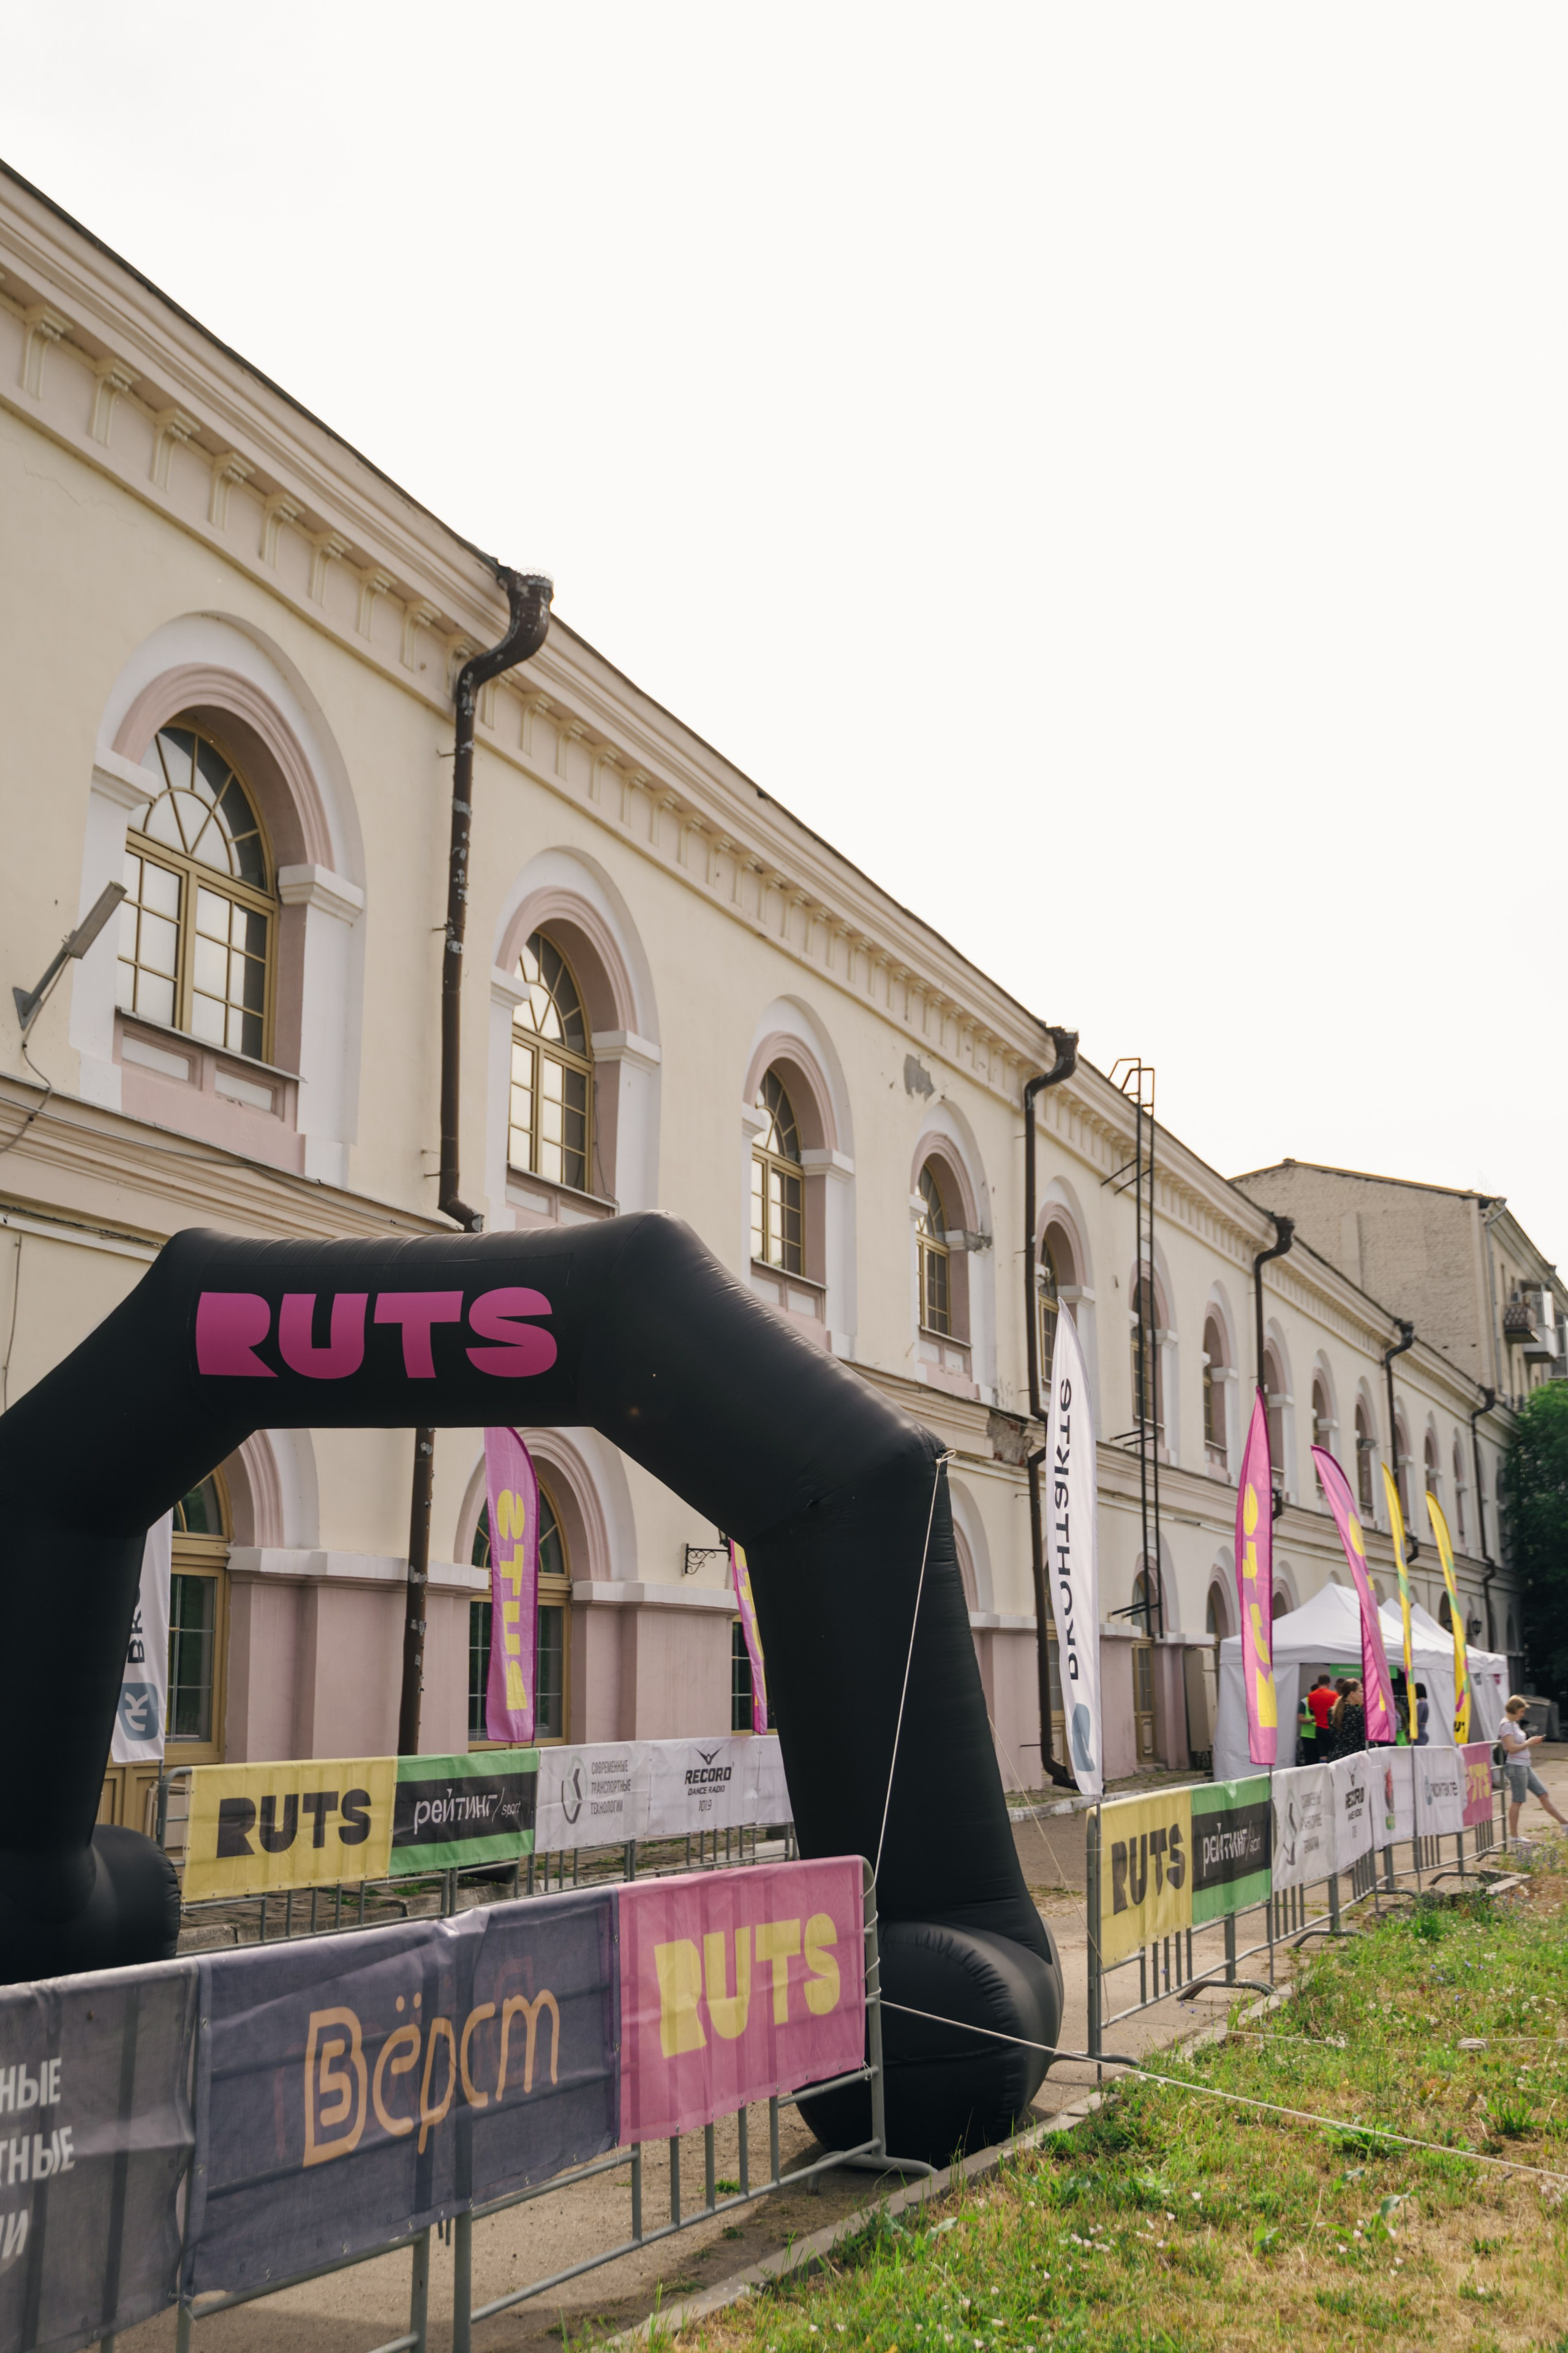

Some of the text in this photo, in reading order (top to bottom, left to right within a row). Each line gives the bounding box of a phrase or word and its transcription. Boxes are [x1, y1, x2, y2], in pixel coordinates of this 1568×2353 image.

[195, 1287, 558, 1380] RUTS
[591, 1759, 628, 1775] СОВРЕМЕННЫЕ
[685, 1767, 732, 1785] RECORD
[590, 1800, 624, 1815] ТЕХНОЛОГИИ
[687, 1785, 725, 1796] DANCE RADIO
[216, 1789, 372, 1859] RUTS
[1111, 1824, 1186, 1915] RUTS
[654, 1913, 841, 2058] RUTS
